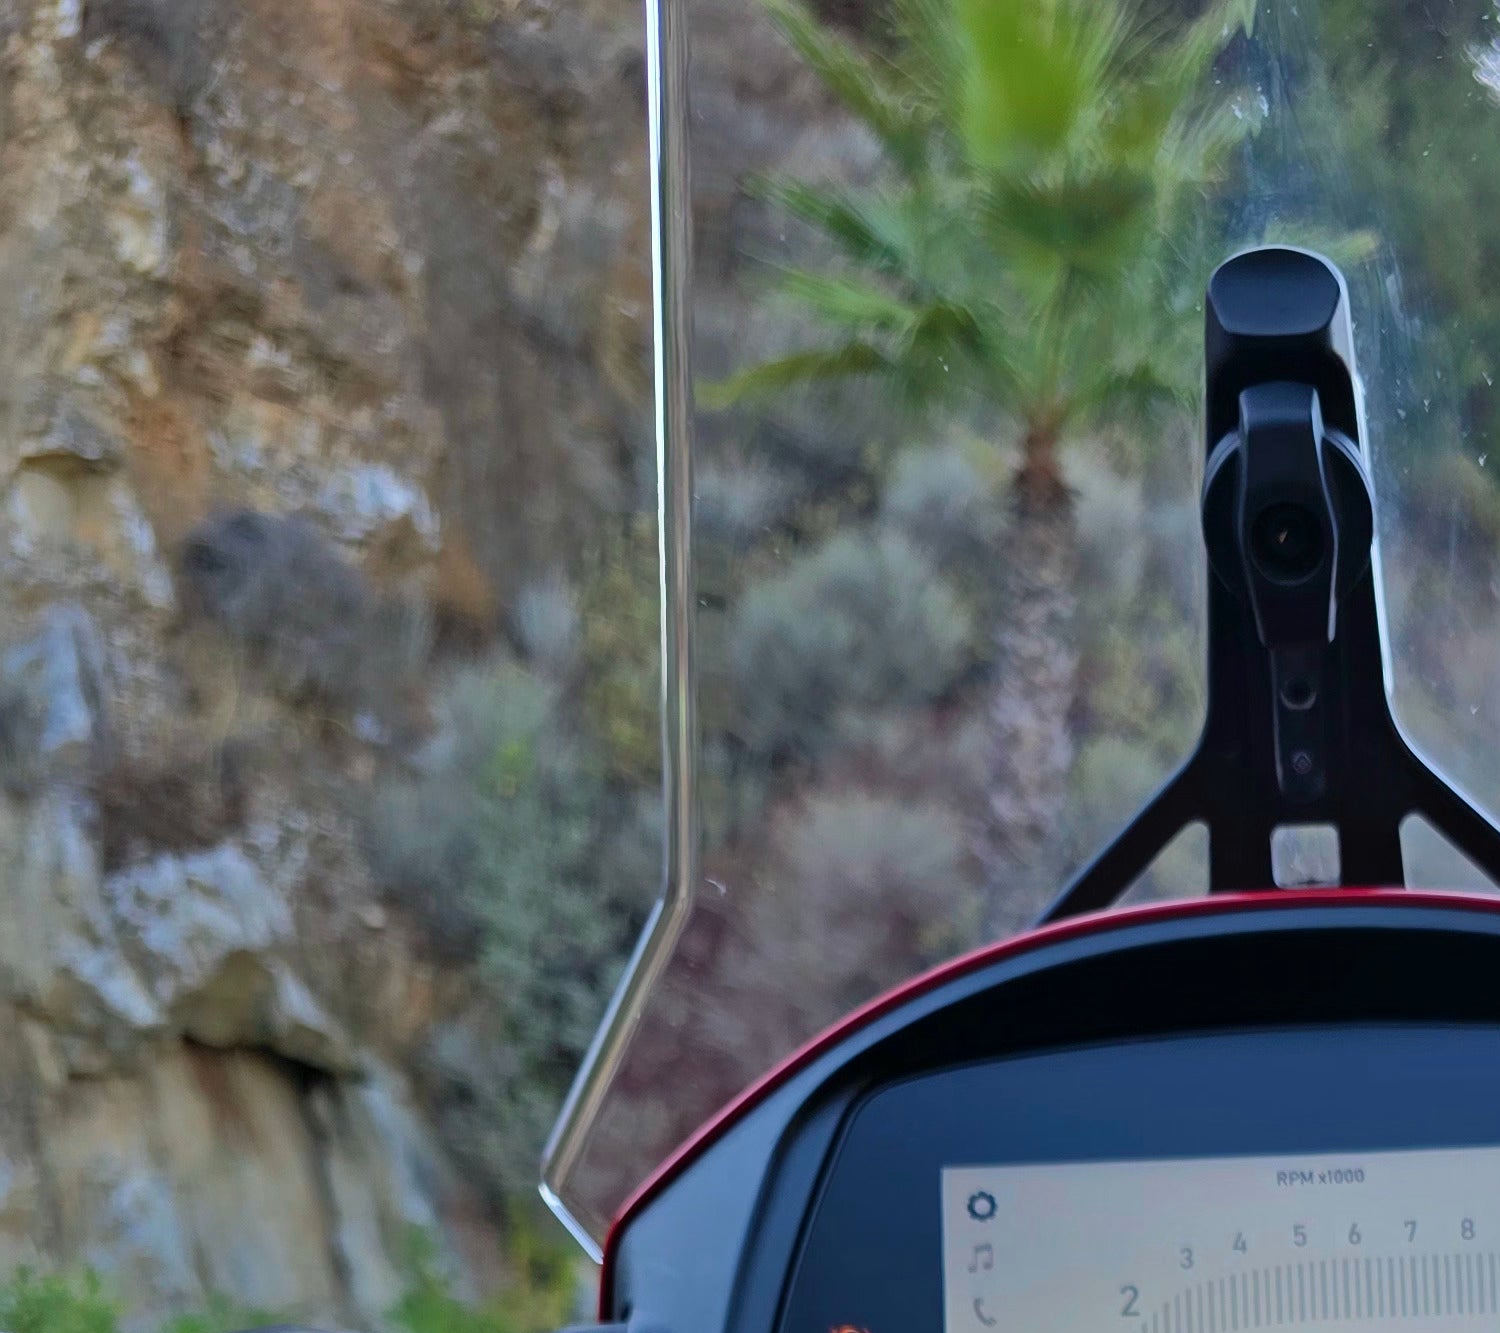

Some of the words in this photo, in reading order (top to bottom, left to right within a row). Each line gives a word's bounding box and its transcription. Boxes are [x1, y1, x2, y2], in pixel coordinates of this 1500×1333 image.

[1276, 1170, 1314, 1186] RPM
[1318, 1168, 1365, 1184] x1000
[1293, 1225, 1307, 1247] 5
[1348, 1222, 1362, 1245] 6
[1404, 1220, 1417, 1242] 7
[1461, 1218, 1475, 1241] 8
[1232, 1232, 1247, 1254] 4
[1179, 1248, 1194, 1270] 3
[1120, 1285, 1140, 1317] 2
